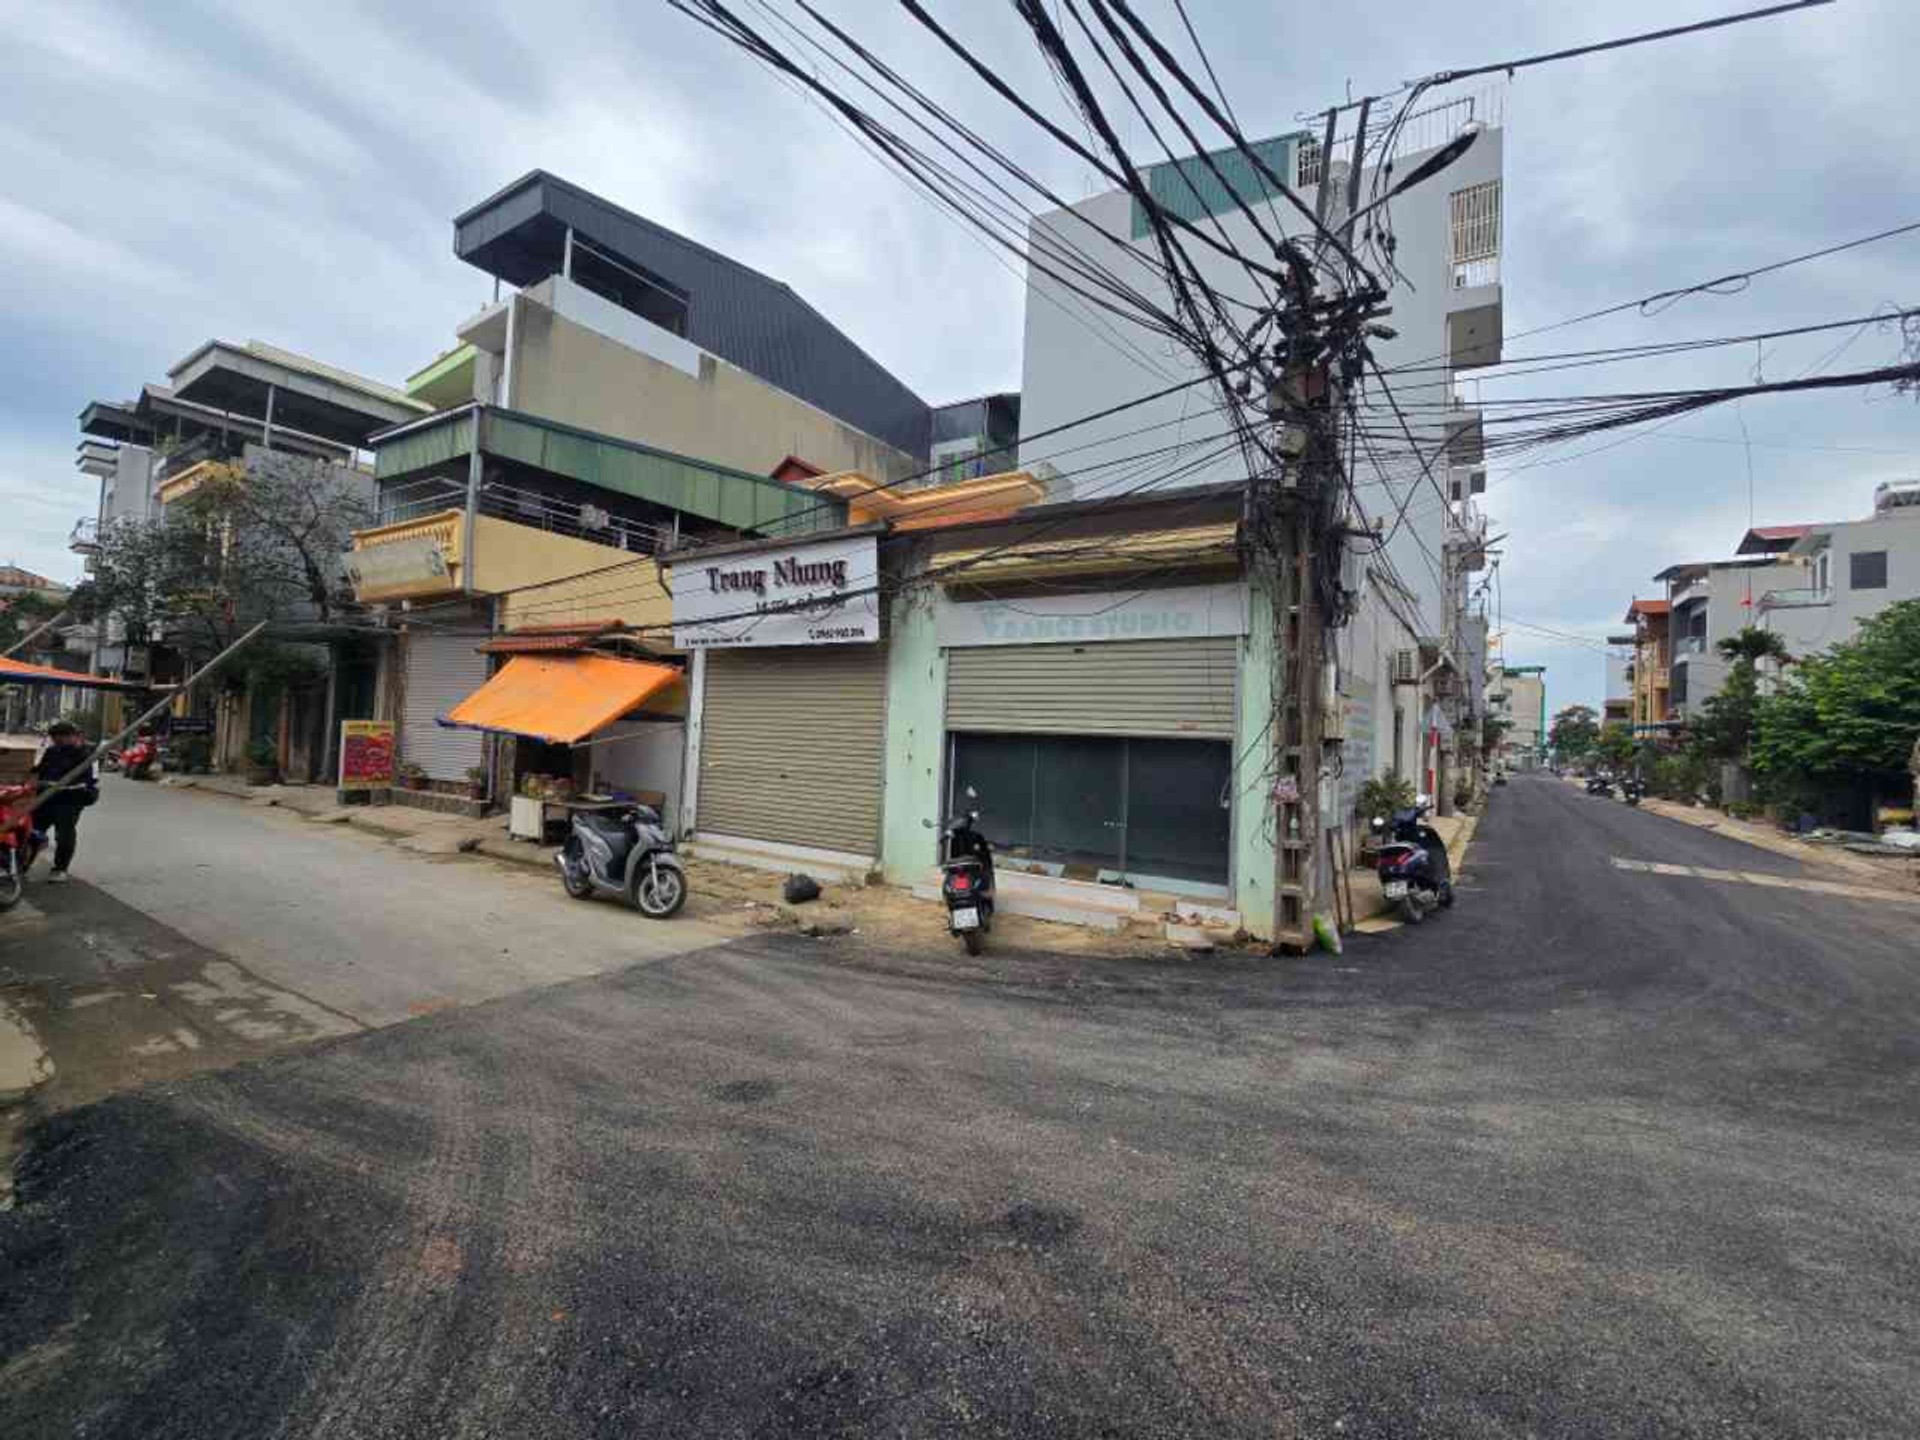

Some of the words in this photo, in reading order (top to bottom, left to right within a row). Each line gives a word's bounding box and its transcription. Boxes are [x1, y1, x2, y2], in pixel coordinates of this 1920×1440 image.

[706, 566, 768, 595] Trang
[773, 556, 848, 588] Nhung
[1091, 610, 1196, 637] STUDIO
